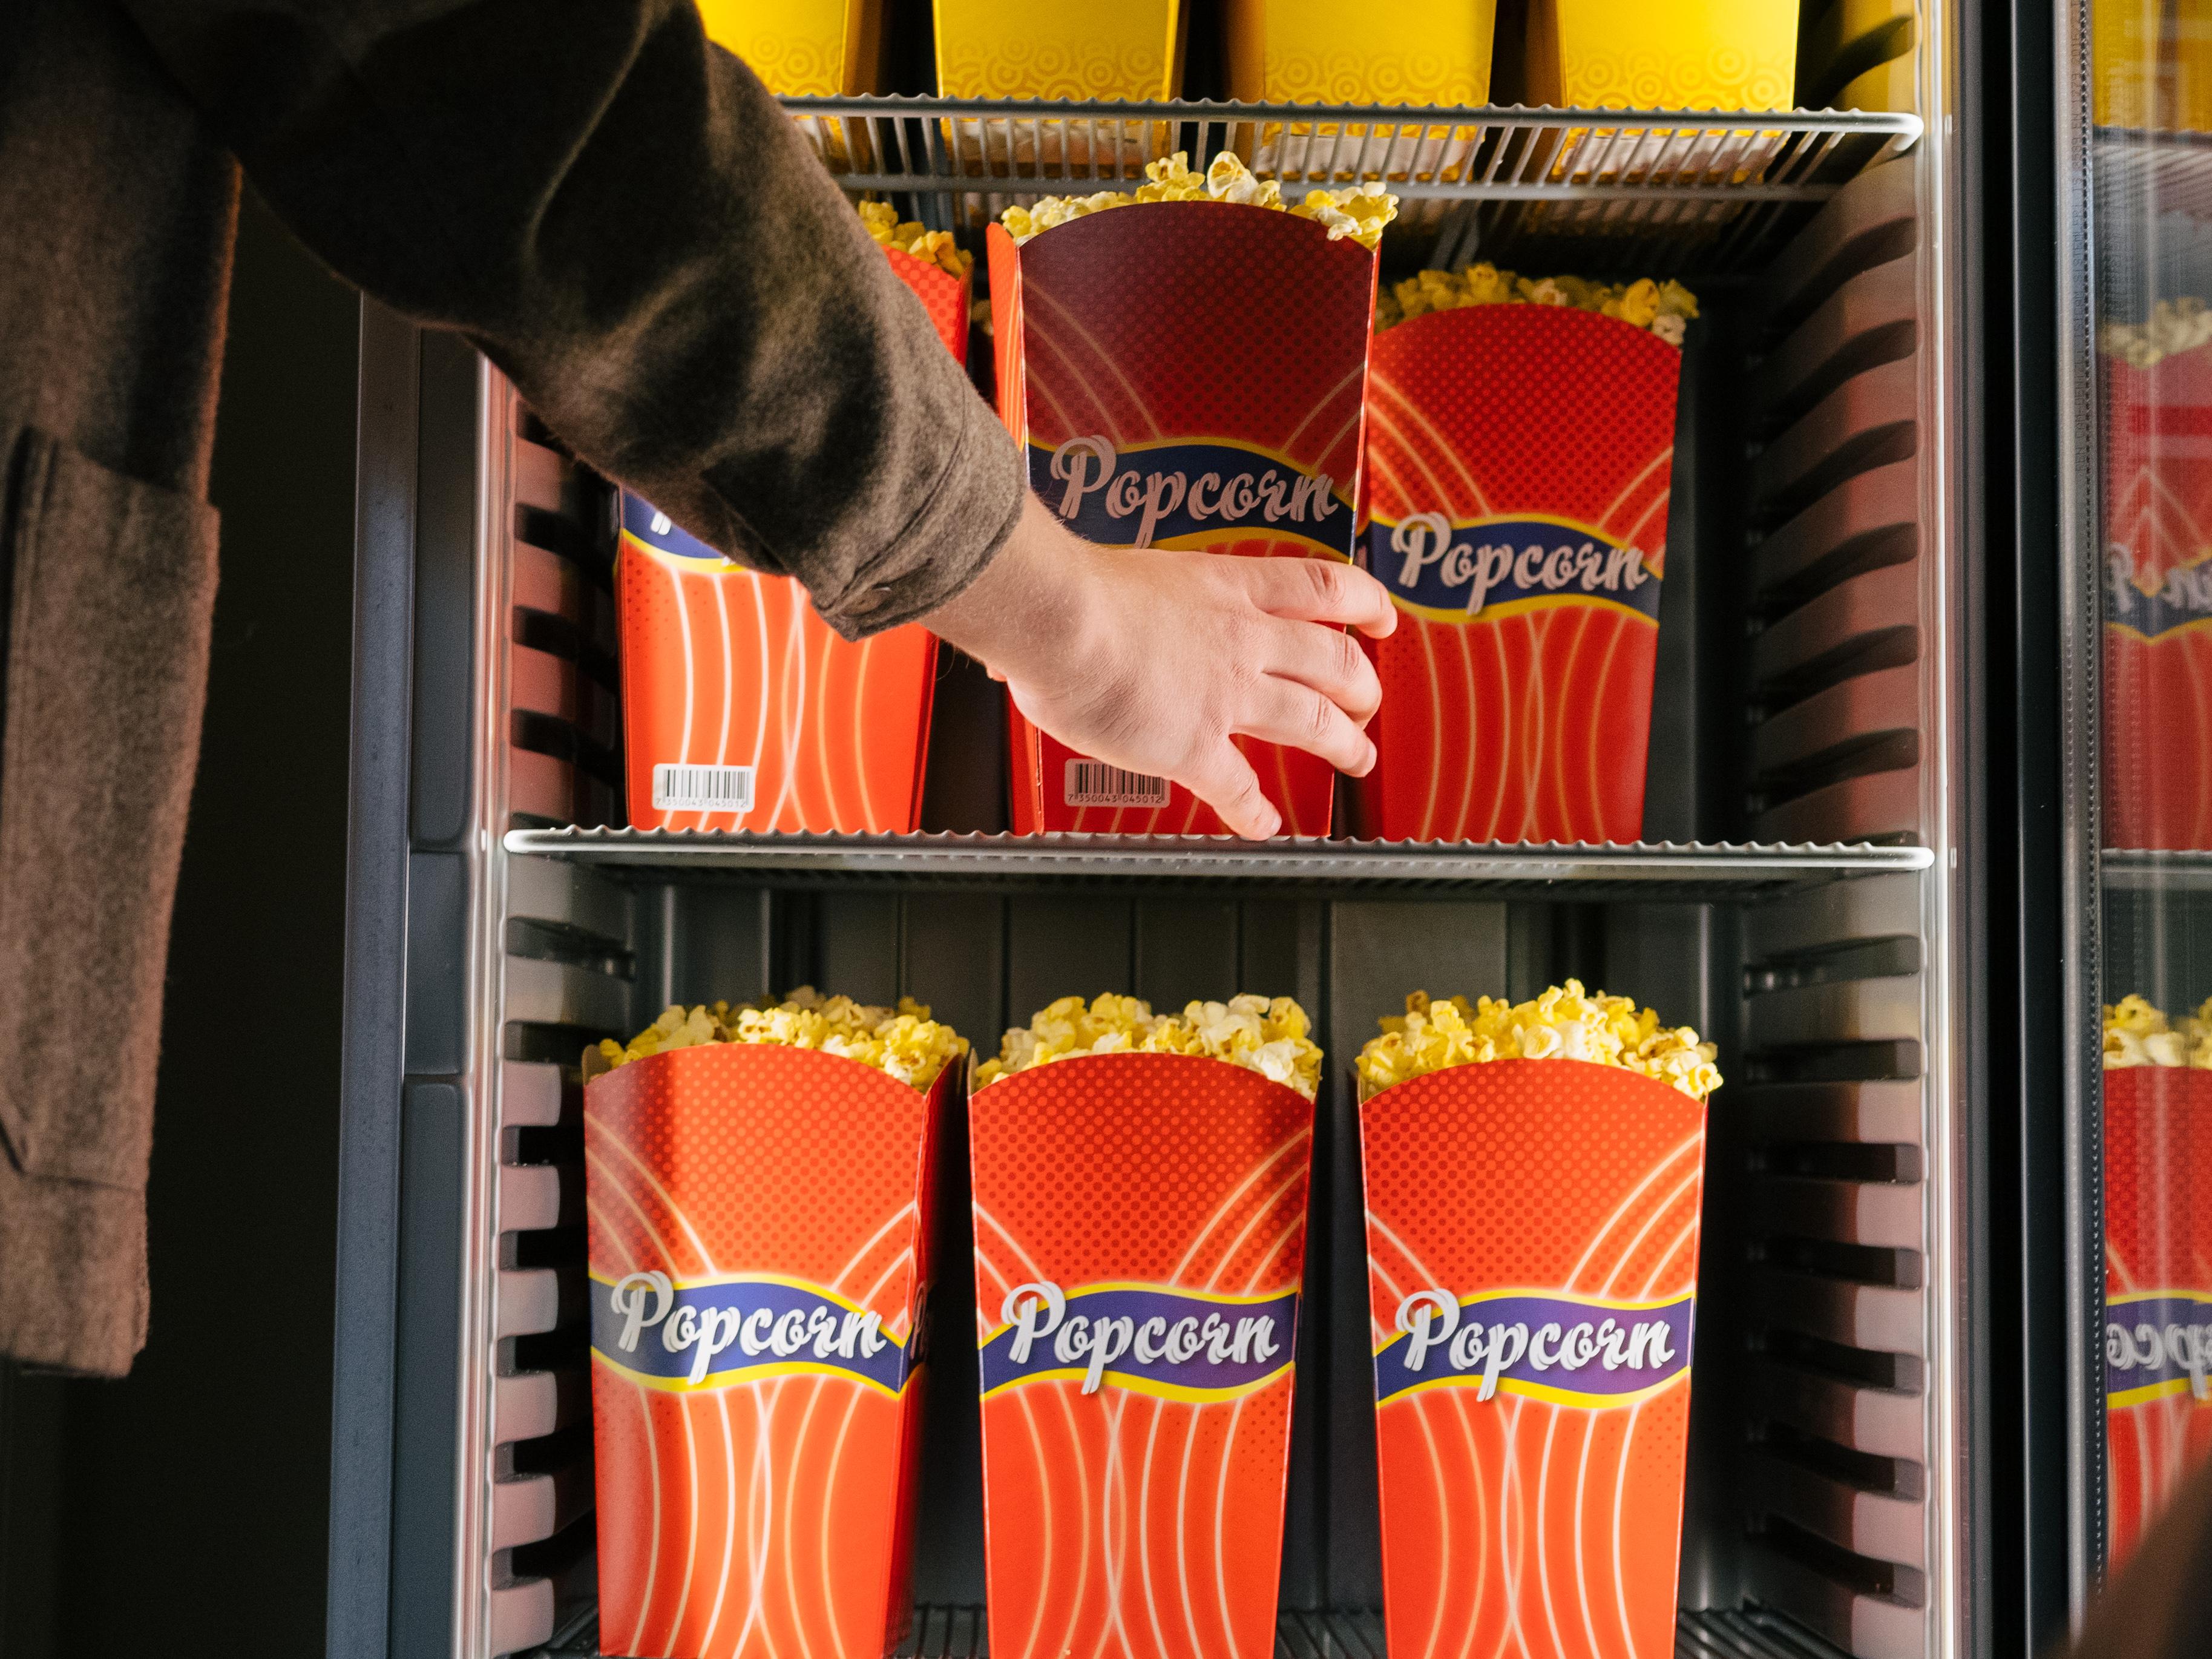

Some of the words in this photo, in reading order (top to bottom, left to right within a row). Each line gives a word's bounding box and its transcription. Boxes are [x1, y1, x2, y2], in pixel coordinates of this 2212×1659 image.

[1050, 435, 1338, 548] Popcorn
[1391, 511, 1649, 615] Popcorn
[611, 1270, 887, 1385] Popcorn
[1001, 1281, 1280, 1395] Popcorn
[1396, 1288, 1675, 1402] Popcorn
